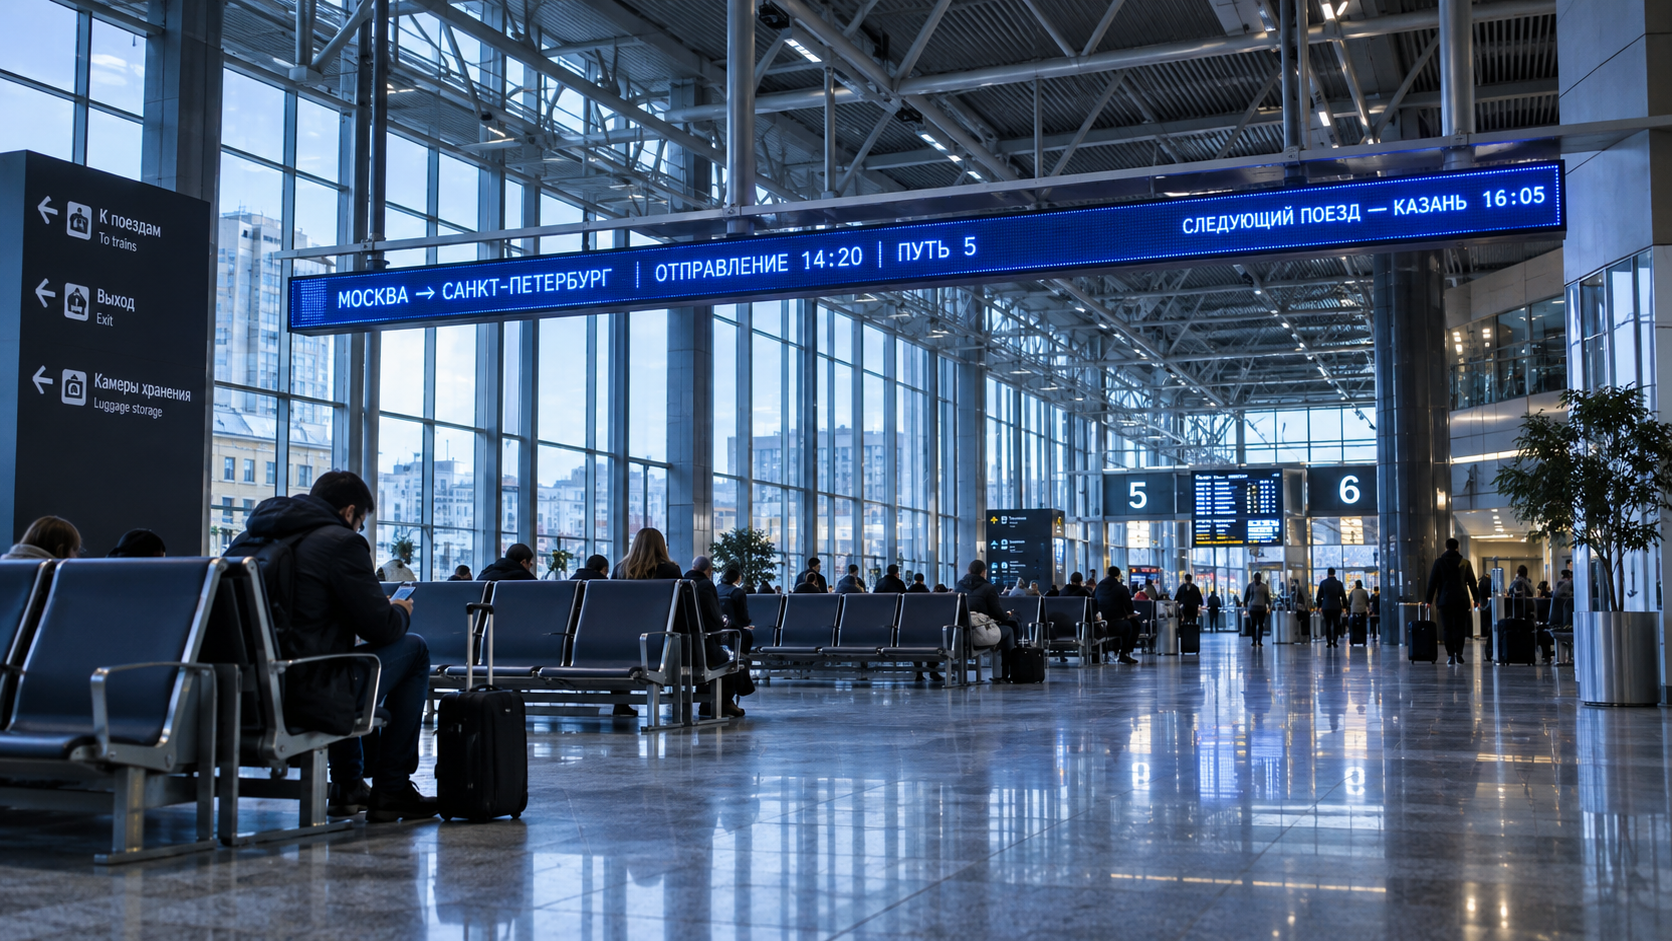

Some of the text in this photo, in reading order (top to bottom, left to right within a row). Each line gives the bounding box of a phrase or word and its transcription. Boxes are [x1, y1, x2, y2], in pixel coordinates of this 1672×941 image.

[99, 208, 162, 238] К поездам
[1182, 206, 1294, 234] СЛЕДУЮЩИЙ
[1301, 203, 1361, 224] ПОЕЗД
[1394, 194, 1467, 216] КАЗАНЬ
[1483, 187, 1546, 208] 16:05
[98, 231, 138, 252] To trains
[338, 236, 976, 309] МОСКВА САНКТ-ПЕТЕРБУРГ ОТПРАВЛЕНИЕ 14:20 ПУТЬ 5
[96, 288, 136, 313] Выход
[96, 312, 114, 327] Exit
[94, 372, 191, 402] Камеры хранения
[94, 397, 163, 418] Luggage storage
[1129, 481, 1148, 509] 5
[1339, 475, 1361, 504] 6
